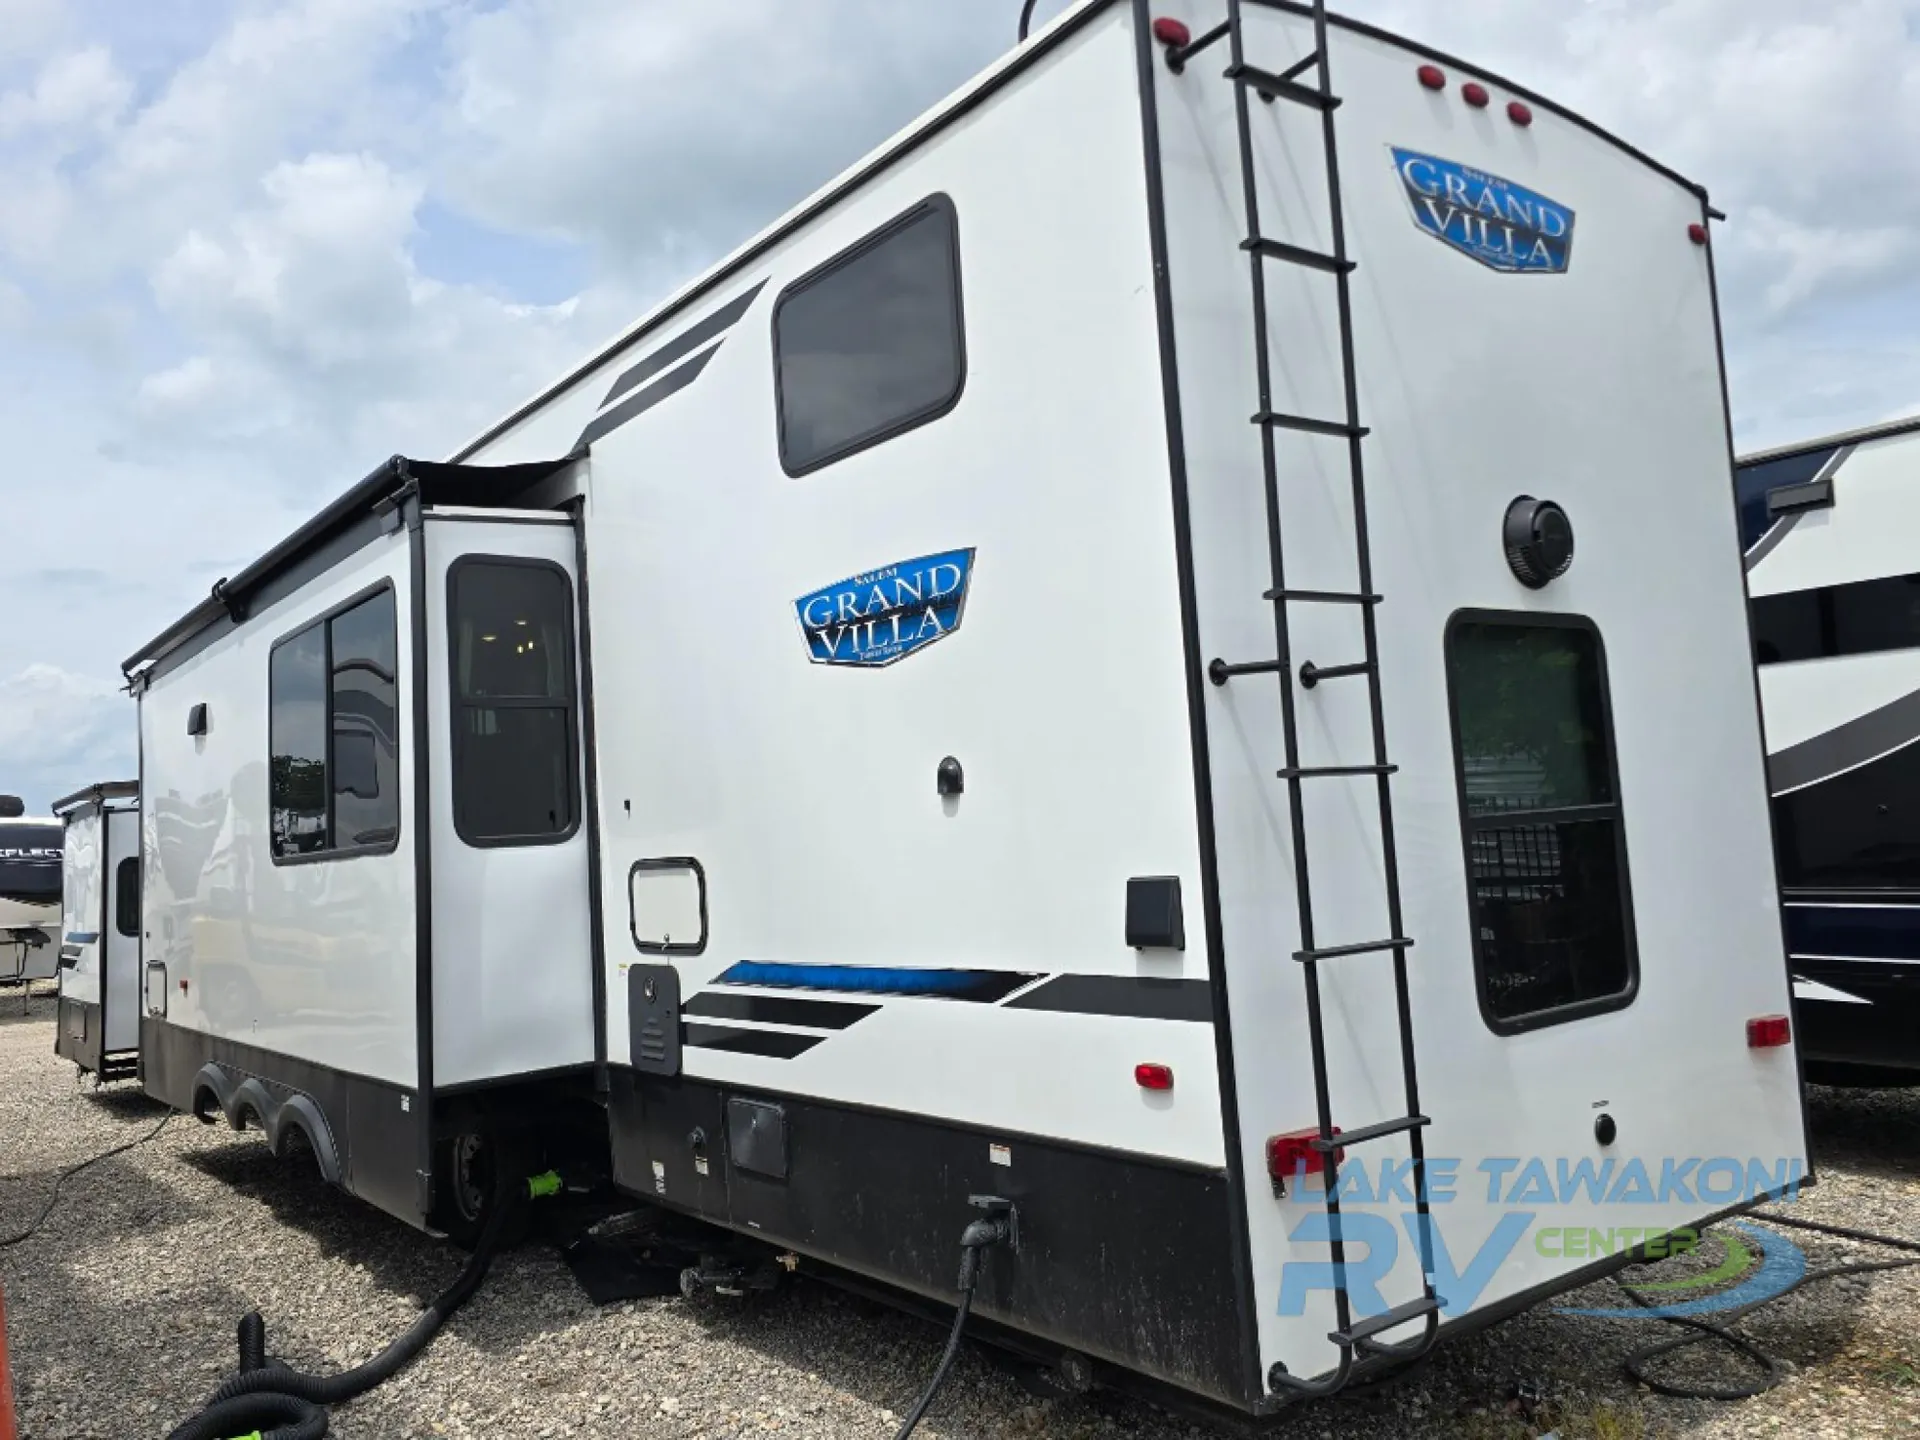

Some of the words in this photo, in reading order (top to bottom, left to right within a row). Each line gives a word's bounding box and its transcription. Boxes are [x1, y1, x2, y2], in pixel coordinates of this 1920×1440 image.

[1402, 157, 1566, 237] GRAND
[1422, 198, 1556, 268] VILLA
[803, 562, 962, 628] GRAND
[854, 567, 897, 587] SALEM
[816, 605, 950, 658] VILLA
